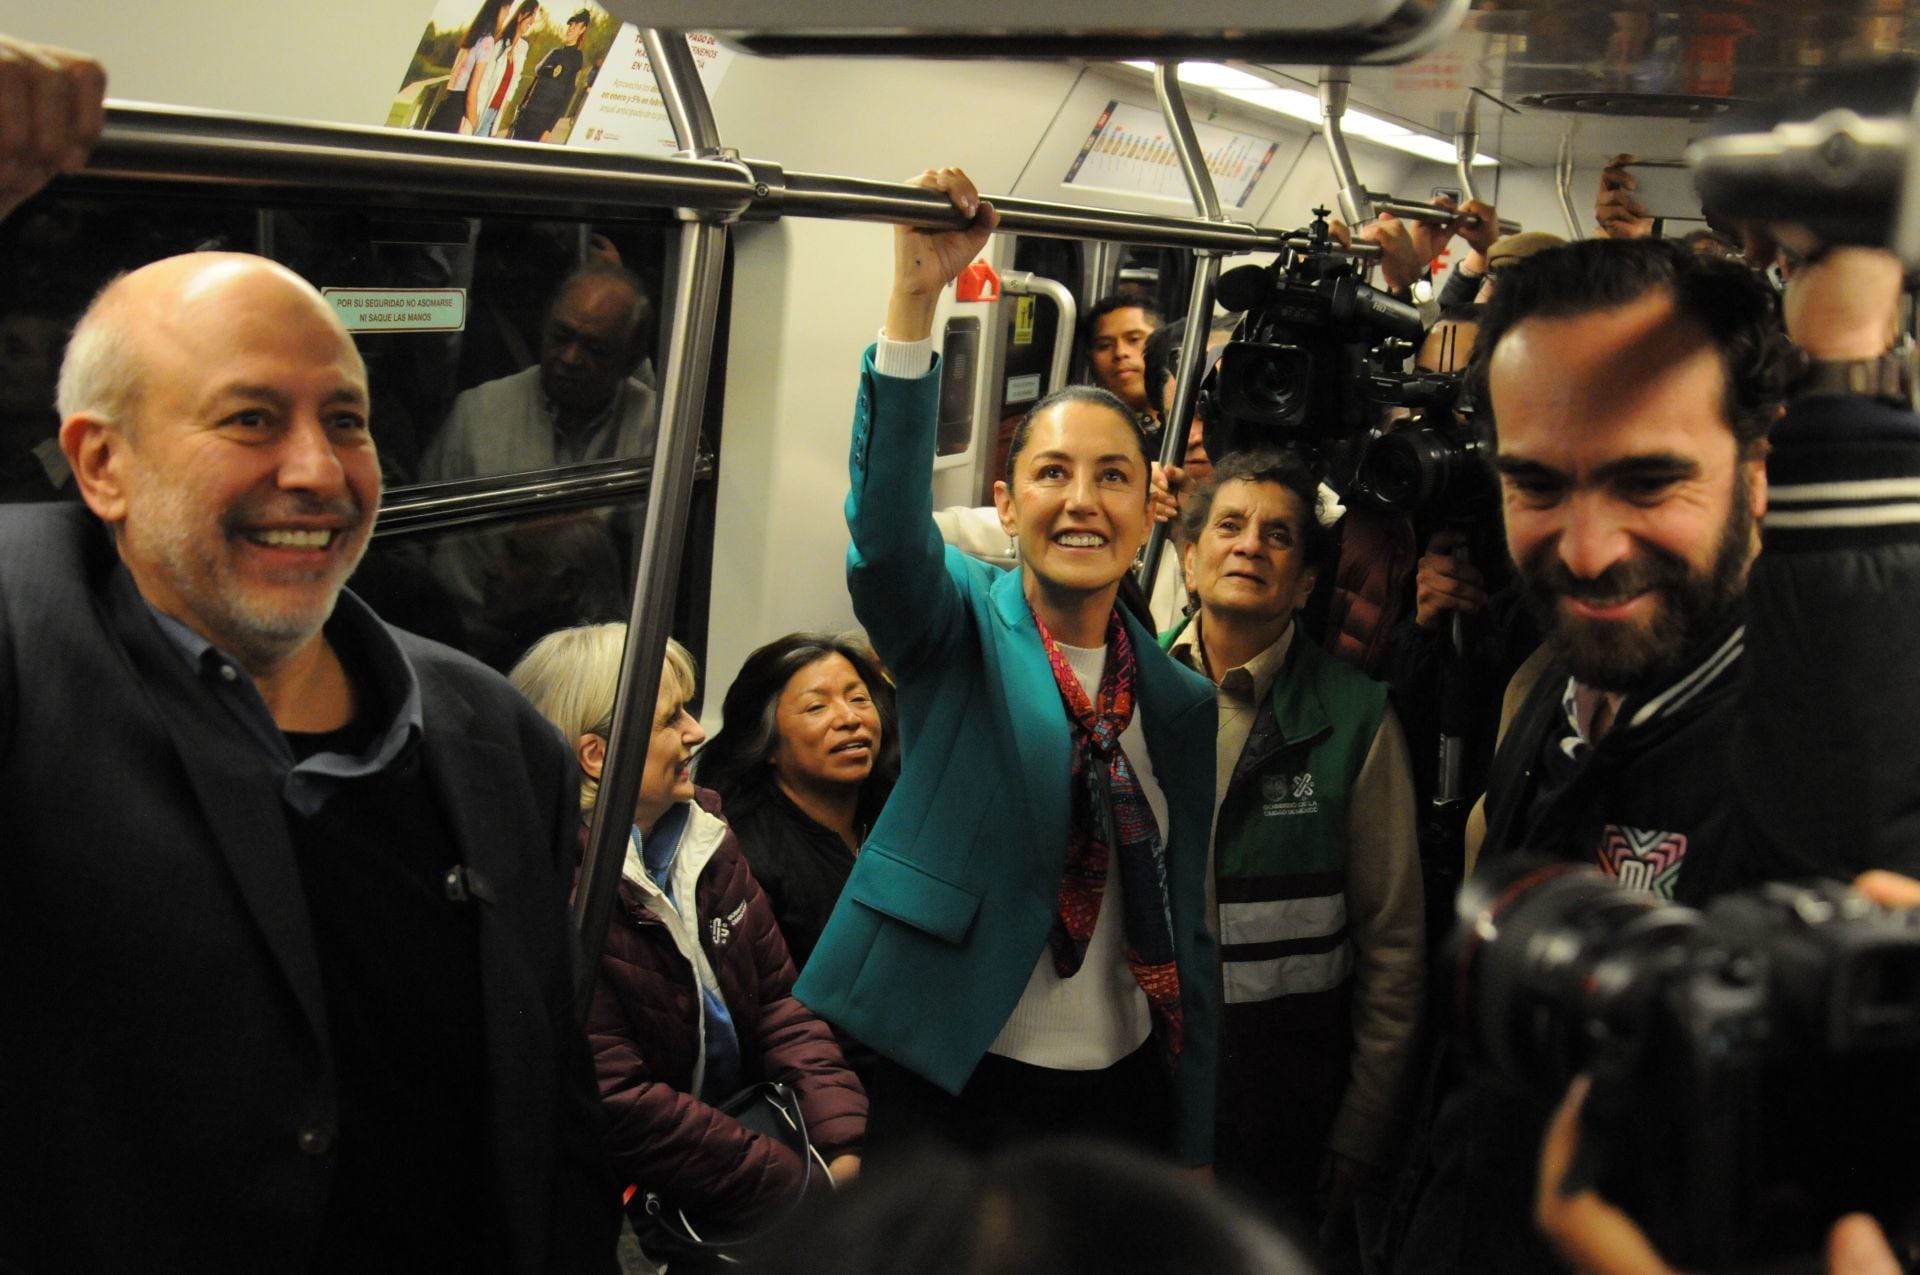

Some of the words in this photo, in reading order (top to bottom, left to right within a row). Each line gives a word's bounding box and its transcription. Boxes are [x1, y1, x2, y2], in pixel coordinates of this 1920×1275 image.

[631, 61, 642, 71] EN
[337, 299, 353, 308] POR
[353, 299, 364, 308] SU
[365, 299, 405, 308] SEGURIDAD
[405, 299, 417, 308] NO
[417, 298, 453, 307] ASOMARSE
[359, 314, 367, 322] NI
[368, 313, 392, 323] SAQUE
[393, 313, 406, 322] LAS
[407, 313, 432, 322] MANOS
